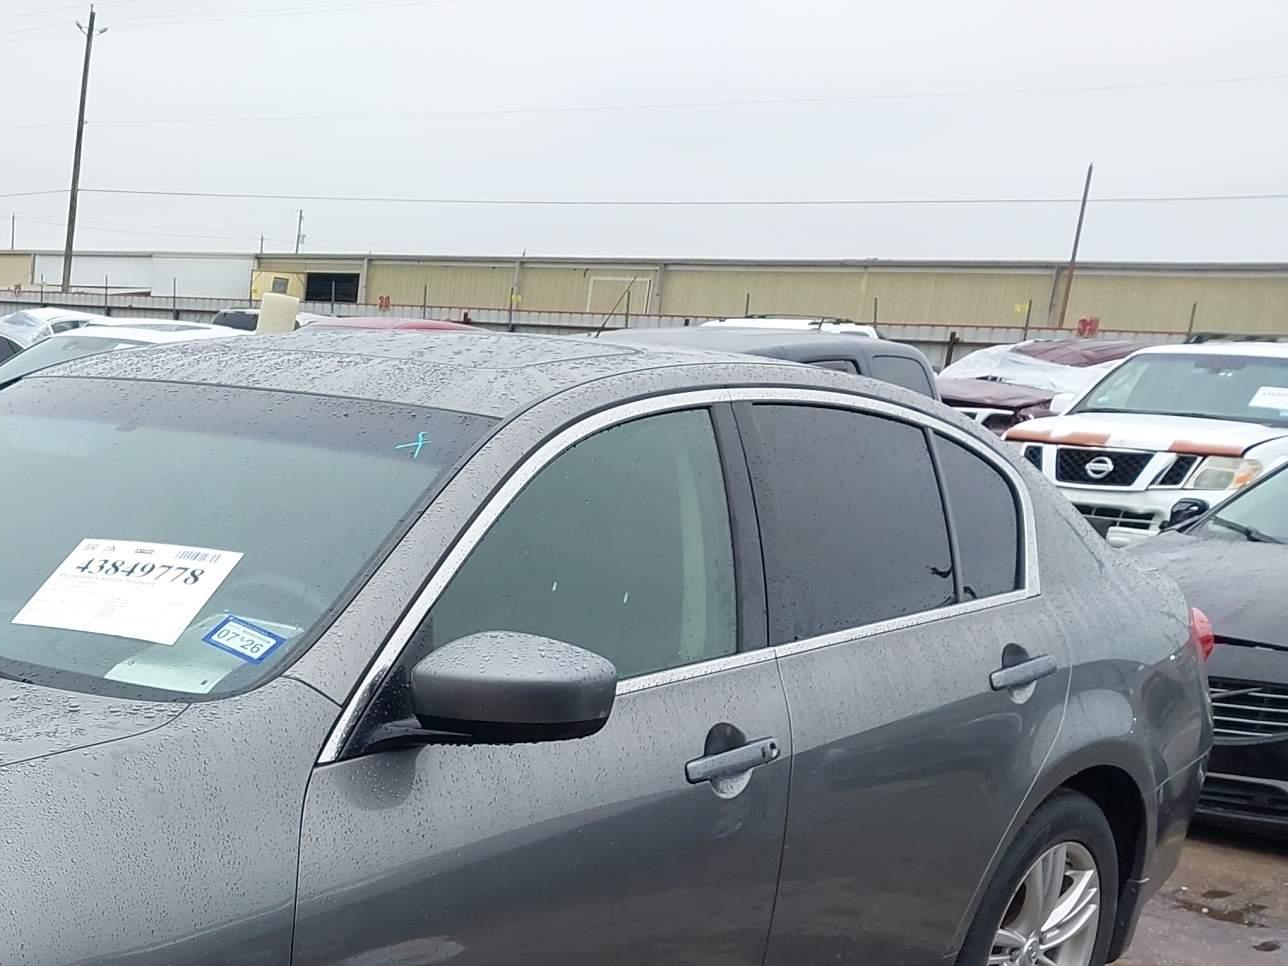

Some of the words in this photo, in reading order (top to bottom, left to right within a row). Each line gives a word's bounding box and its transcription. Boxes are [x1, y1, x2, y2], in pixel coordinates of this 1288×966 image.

[76, 558, 205, 585] 43849778
[216, 628, 240, 642] 07
[239, 639, 264, 654] 26
